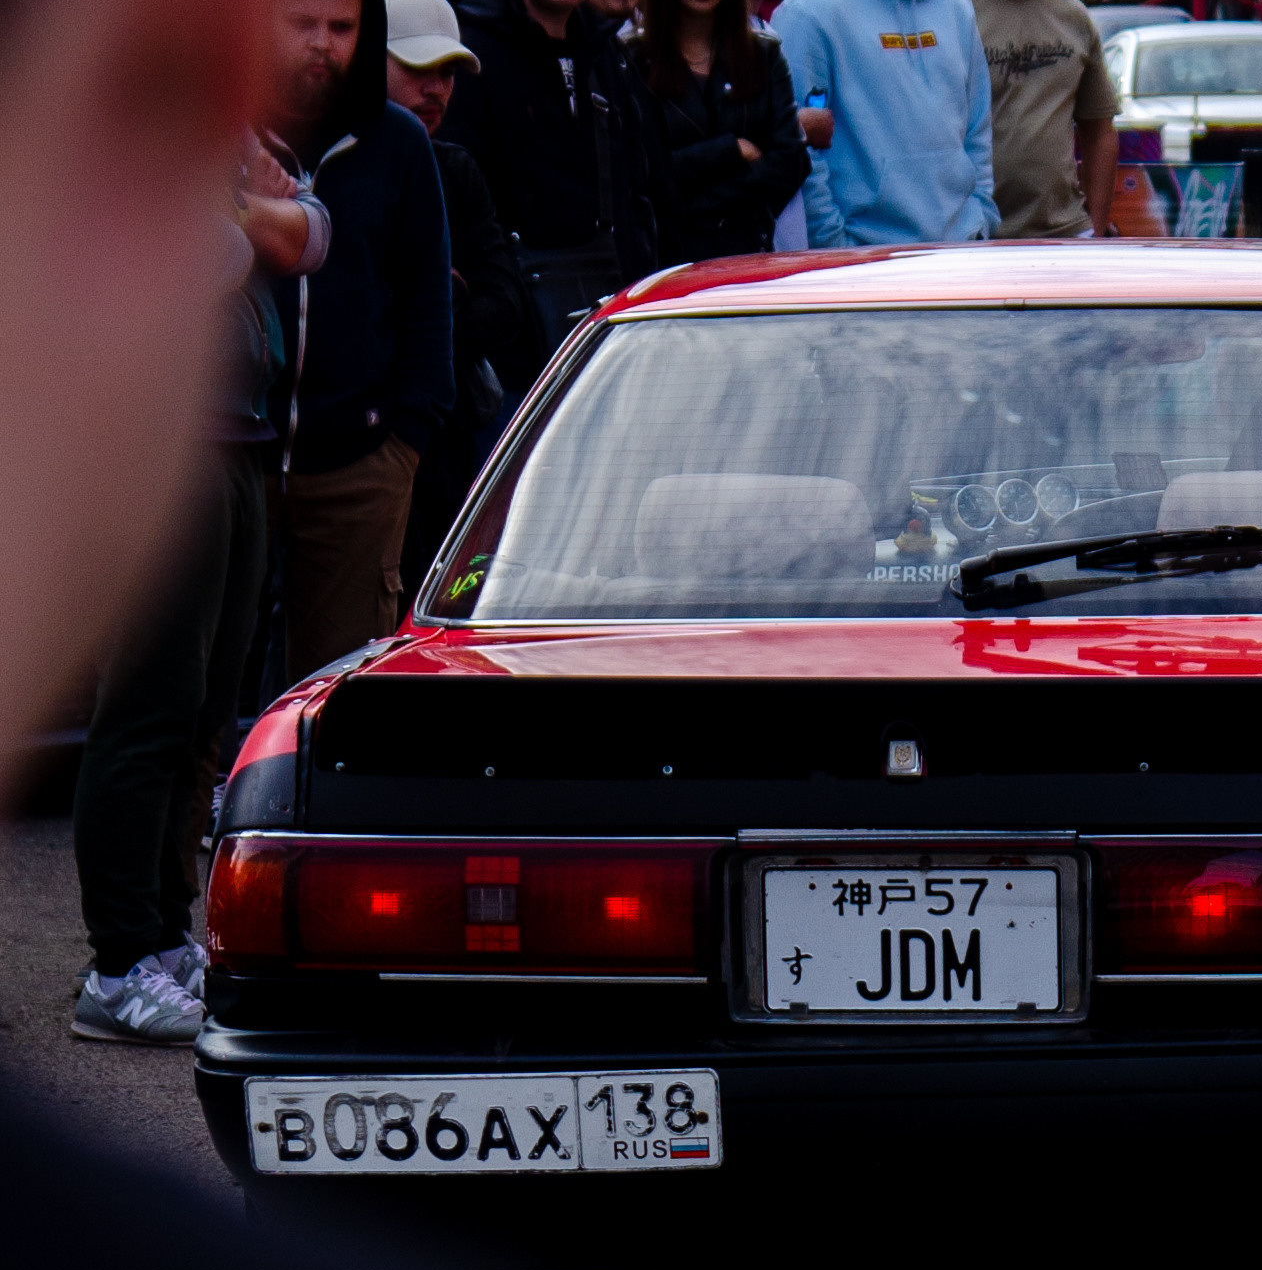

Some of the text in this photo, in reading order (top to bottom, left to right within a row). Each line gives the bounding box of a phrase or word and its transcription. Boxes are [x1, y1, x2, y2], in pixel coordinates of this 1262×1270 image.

[781, 945, 814, 986] す
[856, 928, 982, 1003] JDM
[584, 1081, 697, 1138] 138
[613, 1139, 668, 1160] RUS
